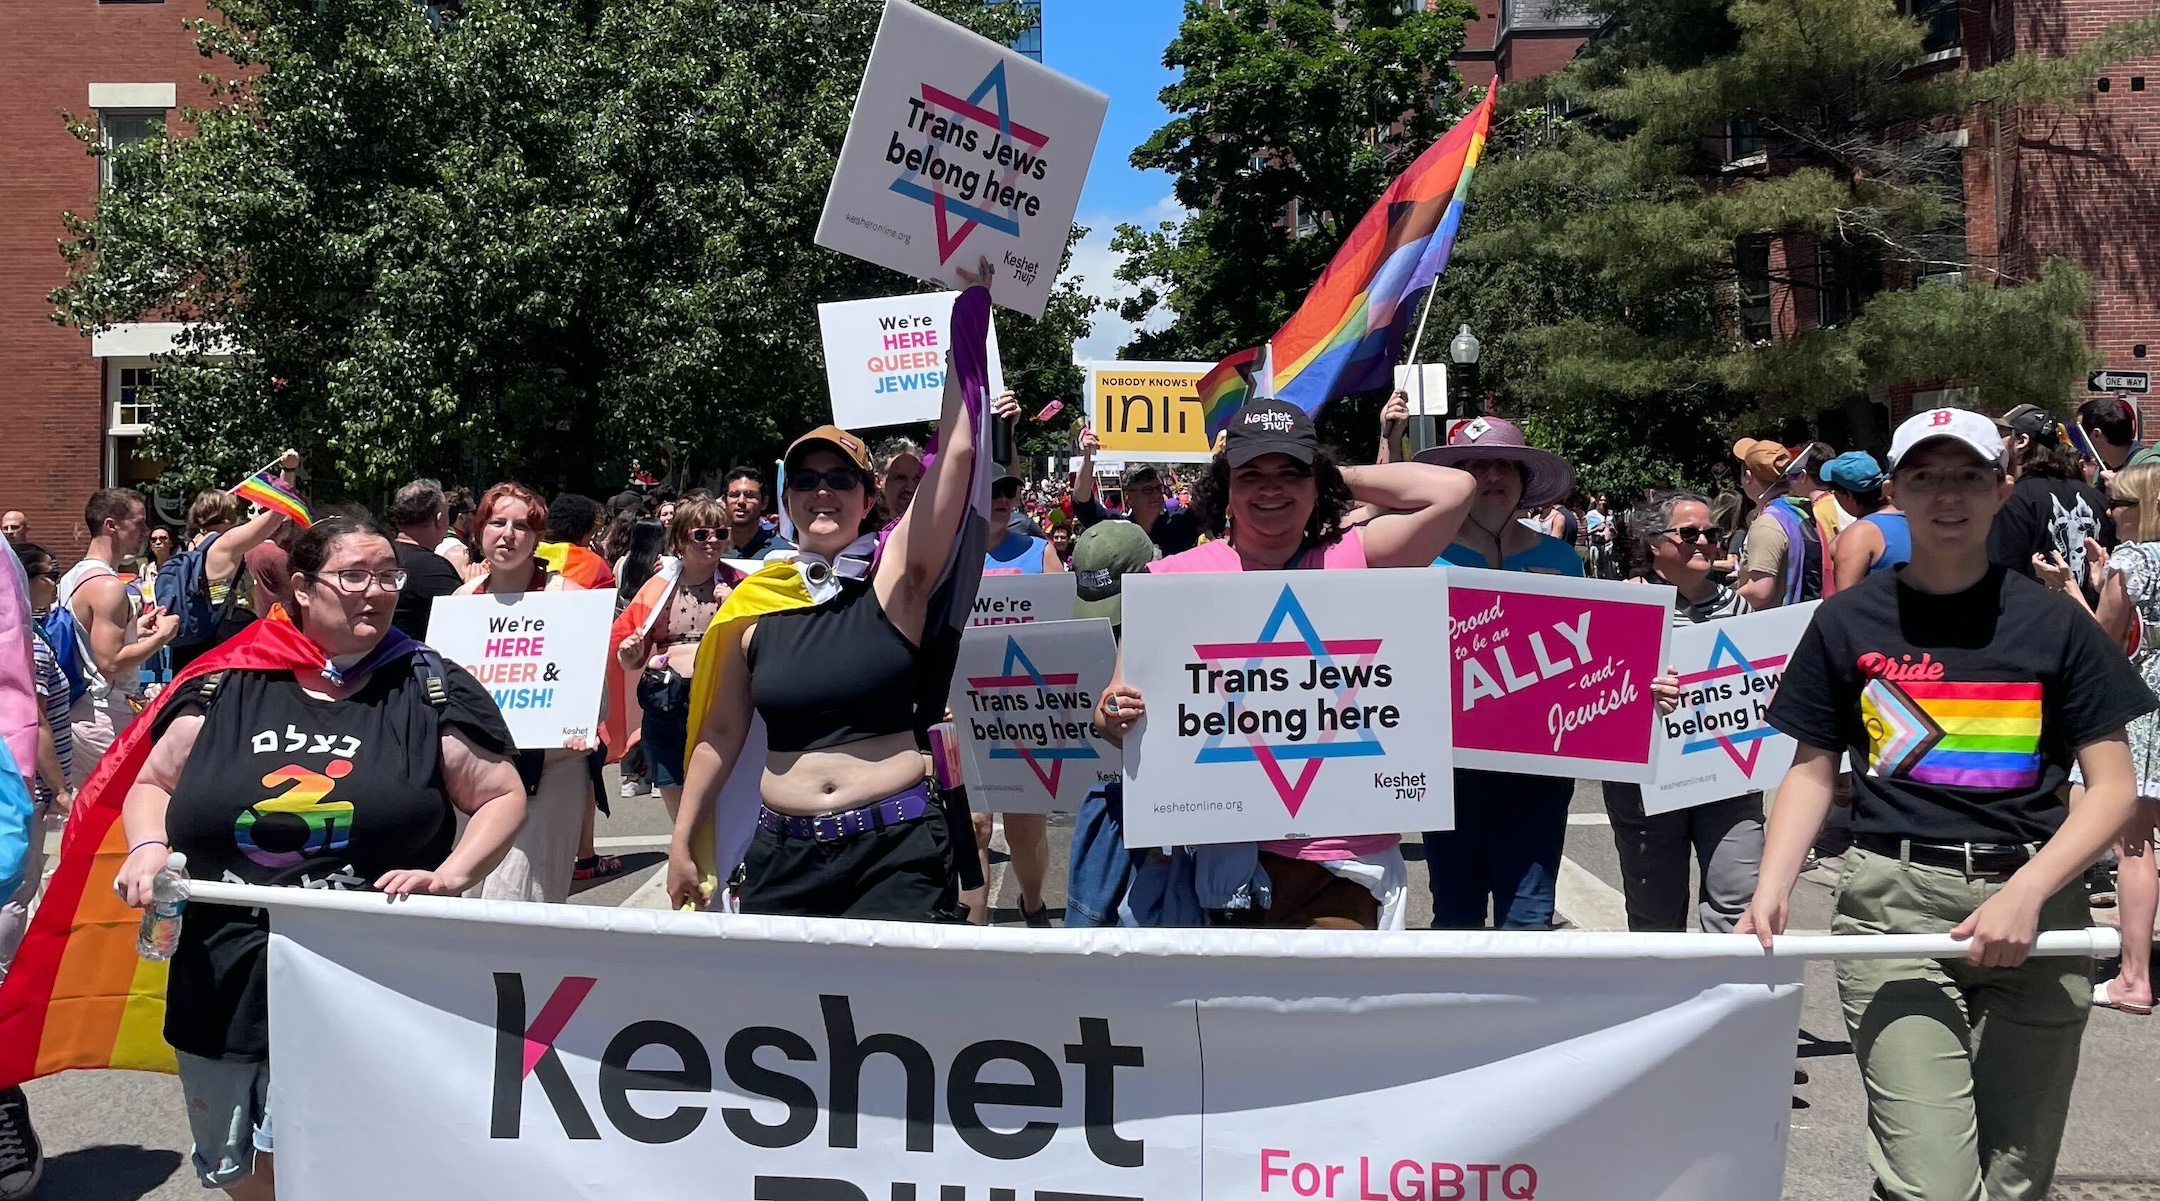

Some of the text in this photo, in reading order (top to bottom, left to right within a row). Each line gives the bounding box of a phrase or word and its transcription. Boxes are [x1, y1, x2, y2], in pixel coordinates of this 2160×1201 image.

[908, 97, 1047, 180] Trans Jews
[886, 131, 1041, 216] belong here
[1003, 250, 1039, 274] Keshet
[1013, 269, 1036, 287] קשת
[879, 315, 932, 330] We're
[883, 330, 938, 350] HERE
[867, 351, 939, 372] QUEER
[1102, 378, 1146, 386] NOBODY
[1149, 379, 1187, 387] KNOWS
[2106, 377, 2142, 386] ONE WAY
[1106, 394, 1202, 433] הומו
[1929, 411, 1953, 427] B
[1262, 421, 1294, 433] קשת
[974, 596, 1032, 612] We're
[489, 616, 545, 633] We're
[485, 637, 545, 658] HERE
[1454, 627, 1510, 660] to be an
[1463, 610, 1593, 711] ALLY
[1857, 651, 1945, 680] Pride
[543, 661, 561, 682] &
[1185, 659, 1393, 694] Trans Jews
[488, 689, 554, 709] WISH!
[966, 688, 1092, 712] Trans Jews
[1678, 673, 1783, 709] rans Jew
[1178, 698, 1400, 742] belong here
[1547, 668, 1639, 753] Jewish
[562, 727, 589, 735] Keshet
[970, 715, 1102, 746] belong here
[1665, 708, 1749, 740] belong
[251, 724, 362, 758] בצלם
[1096, 770, 1123, 783] Kesh
[1374, 771, 1427, 788] Keshet
[1395, 787, 1427, 802] קשת
[1153, 800, 1244, 814] keshetonline.org
[490, 972, 1144, 1168] Keshet
[1260, 1148, 1538, 1201] For LGBTQ
